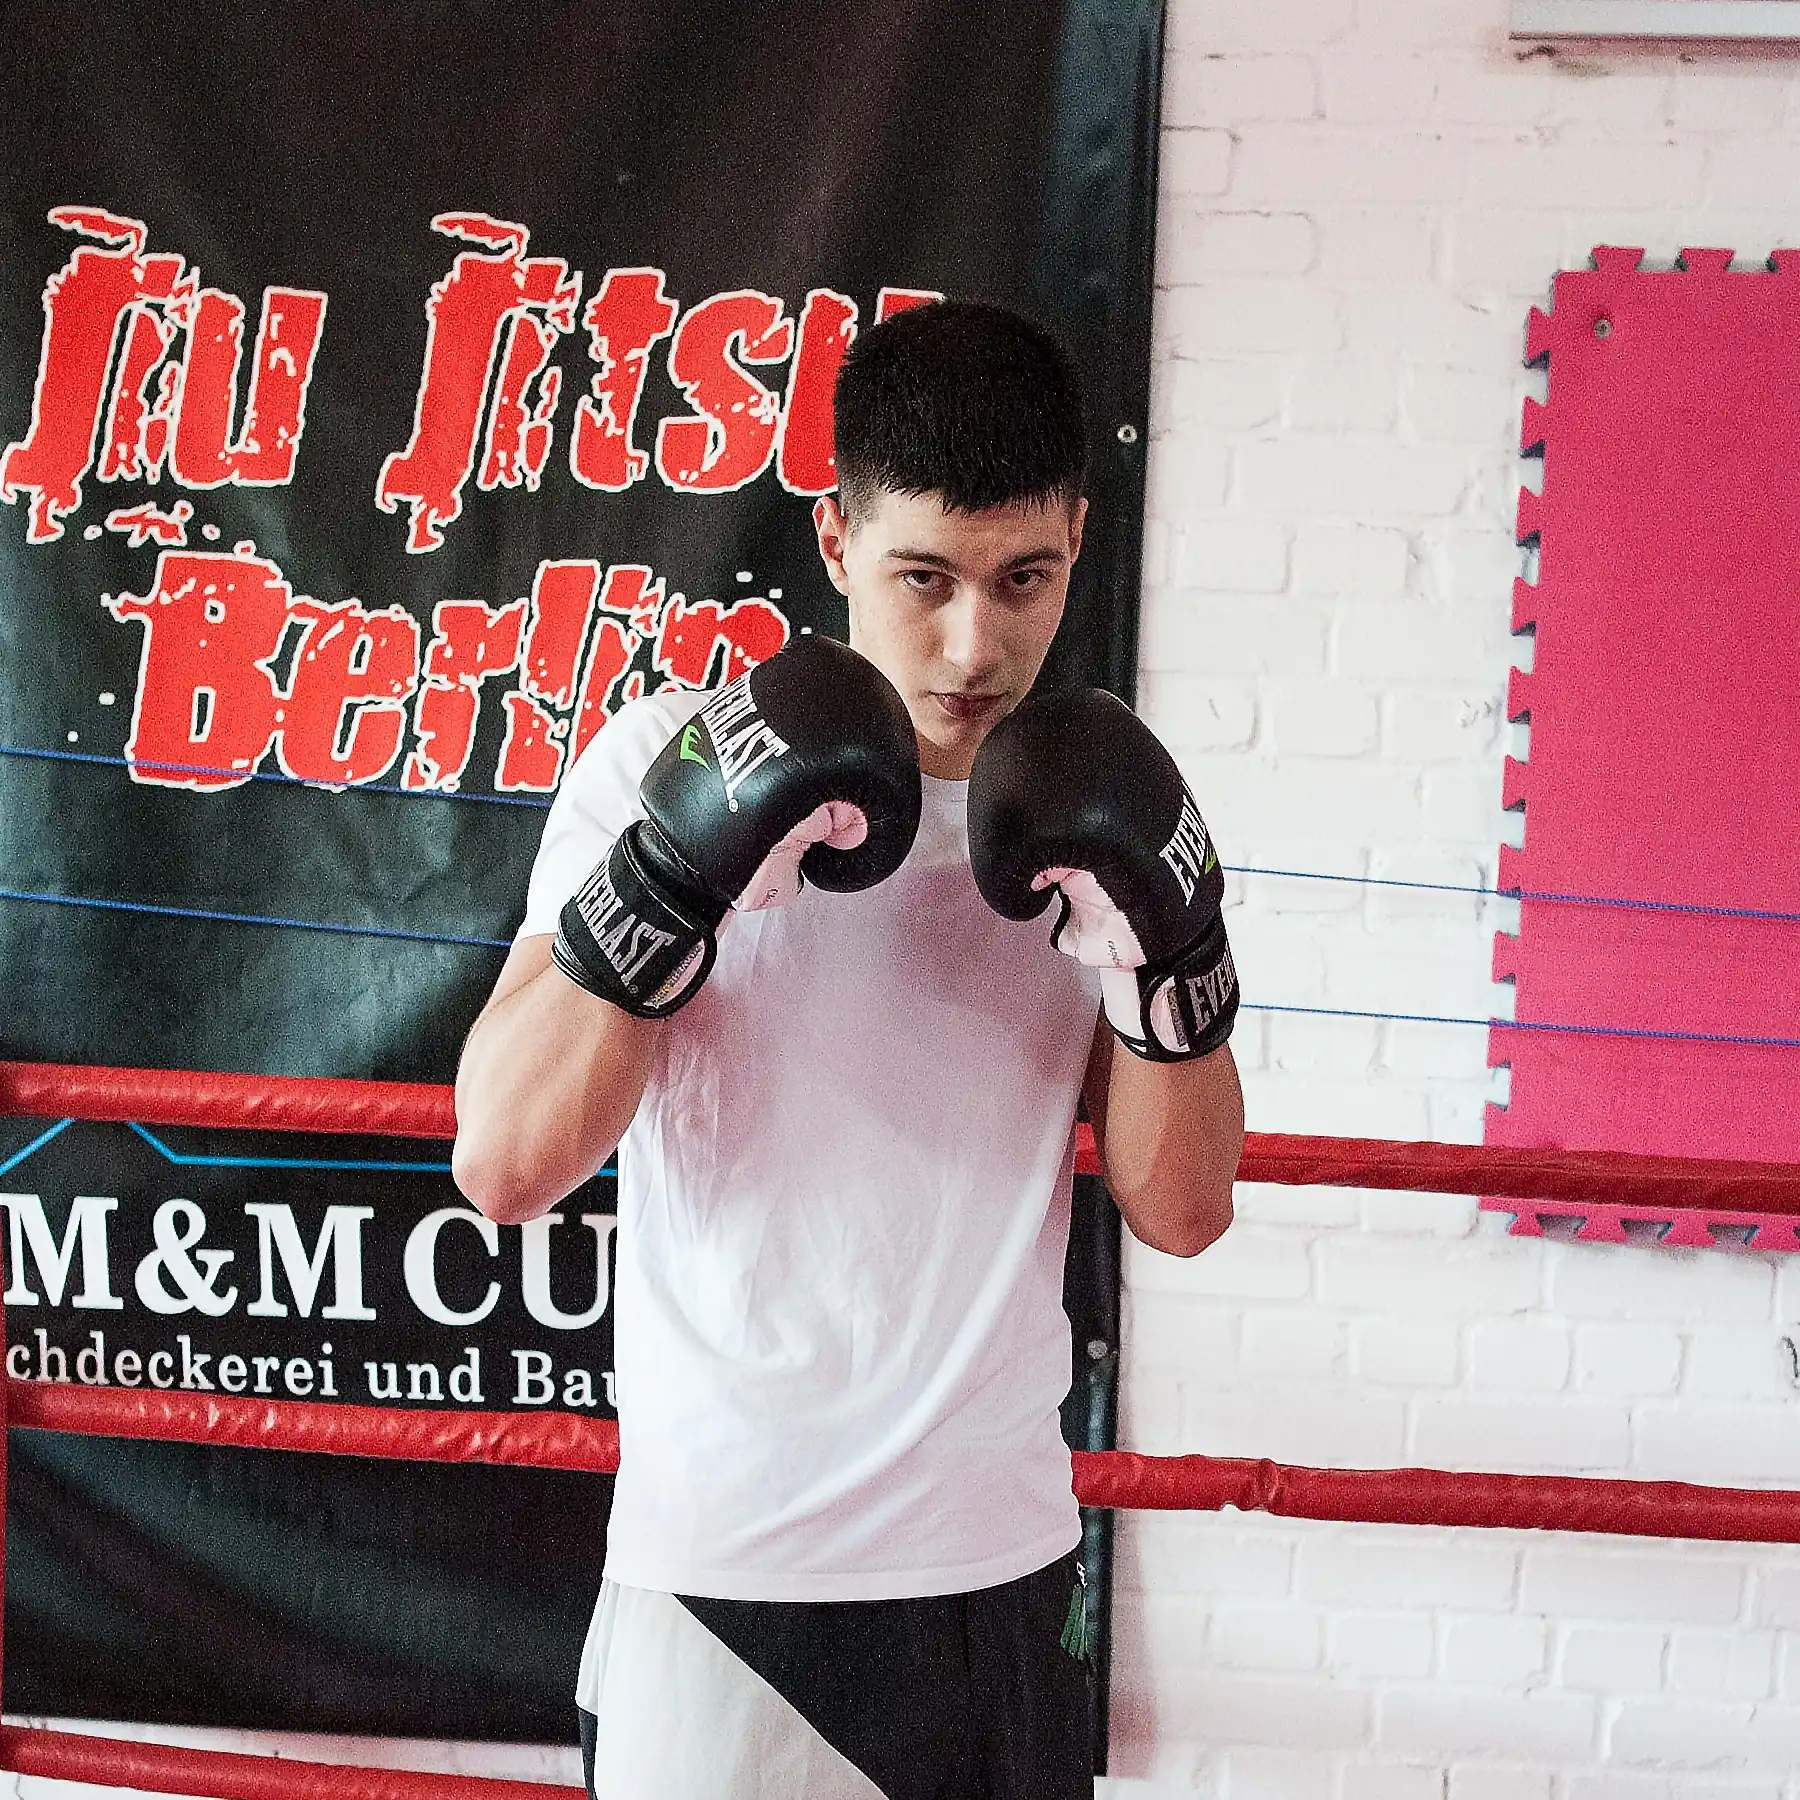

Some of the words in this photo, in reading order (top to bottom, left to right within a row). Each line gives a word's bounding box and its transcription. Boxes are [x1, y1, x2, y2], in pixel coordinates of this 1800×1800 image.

[1, 206, 328, 545] Jiu
[575, 846, 677, 985] VERLAST
[0, 1192, 376, 1321] M&M
[5, 1328, 340, 1398] chdeckerei
[364, 1349, 485, 1404] und
